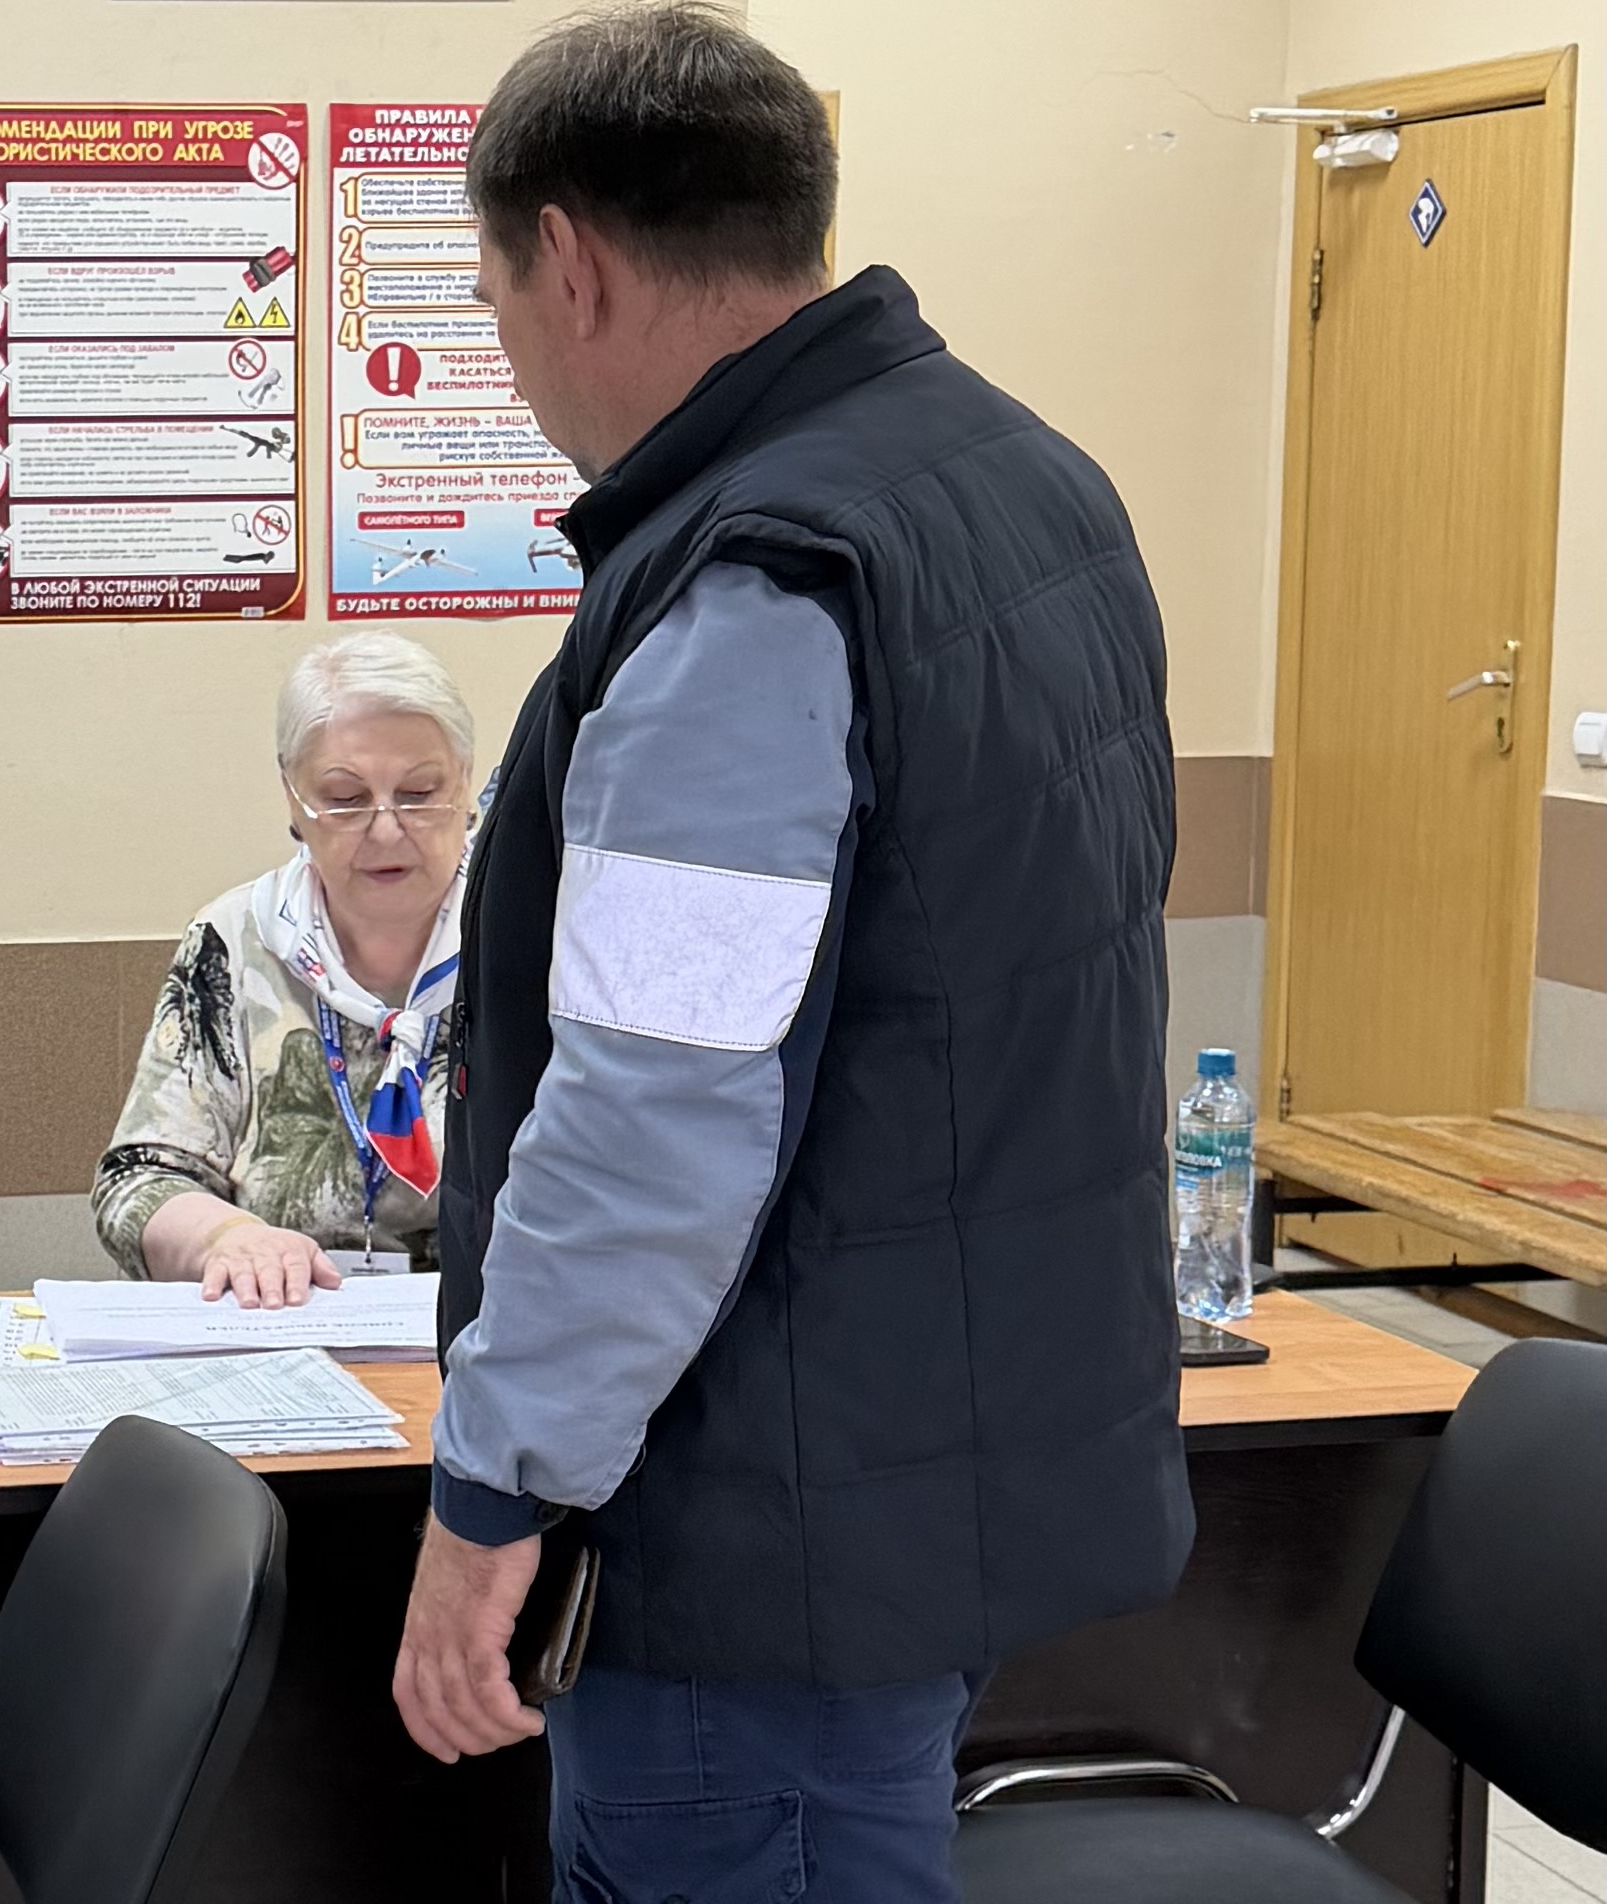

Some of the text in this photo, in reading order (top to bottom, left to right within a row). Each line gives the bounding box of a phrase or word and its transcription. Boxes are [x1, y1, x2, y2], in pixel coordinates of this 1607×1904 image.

[374, 109, 471, 125] ПРАВИЛА
[133, 120, 173, 139] ПРИ
[183, 120, 254, 140] УГРОЗЕ
[173, 142, 225, 162] АКТА
[448, 367, 512, 377] КАСАТЬСЯ
[433, 416, 481, 428] ЖИЗНЬ
[495, 415, 533, 427] ВАША
[375, 472, 484, 491] Экстренный
[490, 469, 567, 490] телефон
[356, 493, 423, 504] Позвоните
[10, 578, 261, 595] В ЛЮБОЙ ЭКСТРЕННОЙ СИТУАЦИИ
[10, 592, 201, 610] ЗВОНИТЕ ПО НОМЕРУ 112!
[336, 597, 400, 612] БУДЬТЕ
[407, 595, 518, 611] ОСТОРОЖНЫ
[522, 595, 536, 608] И
